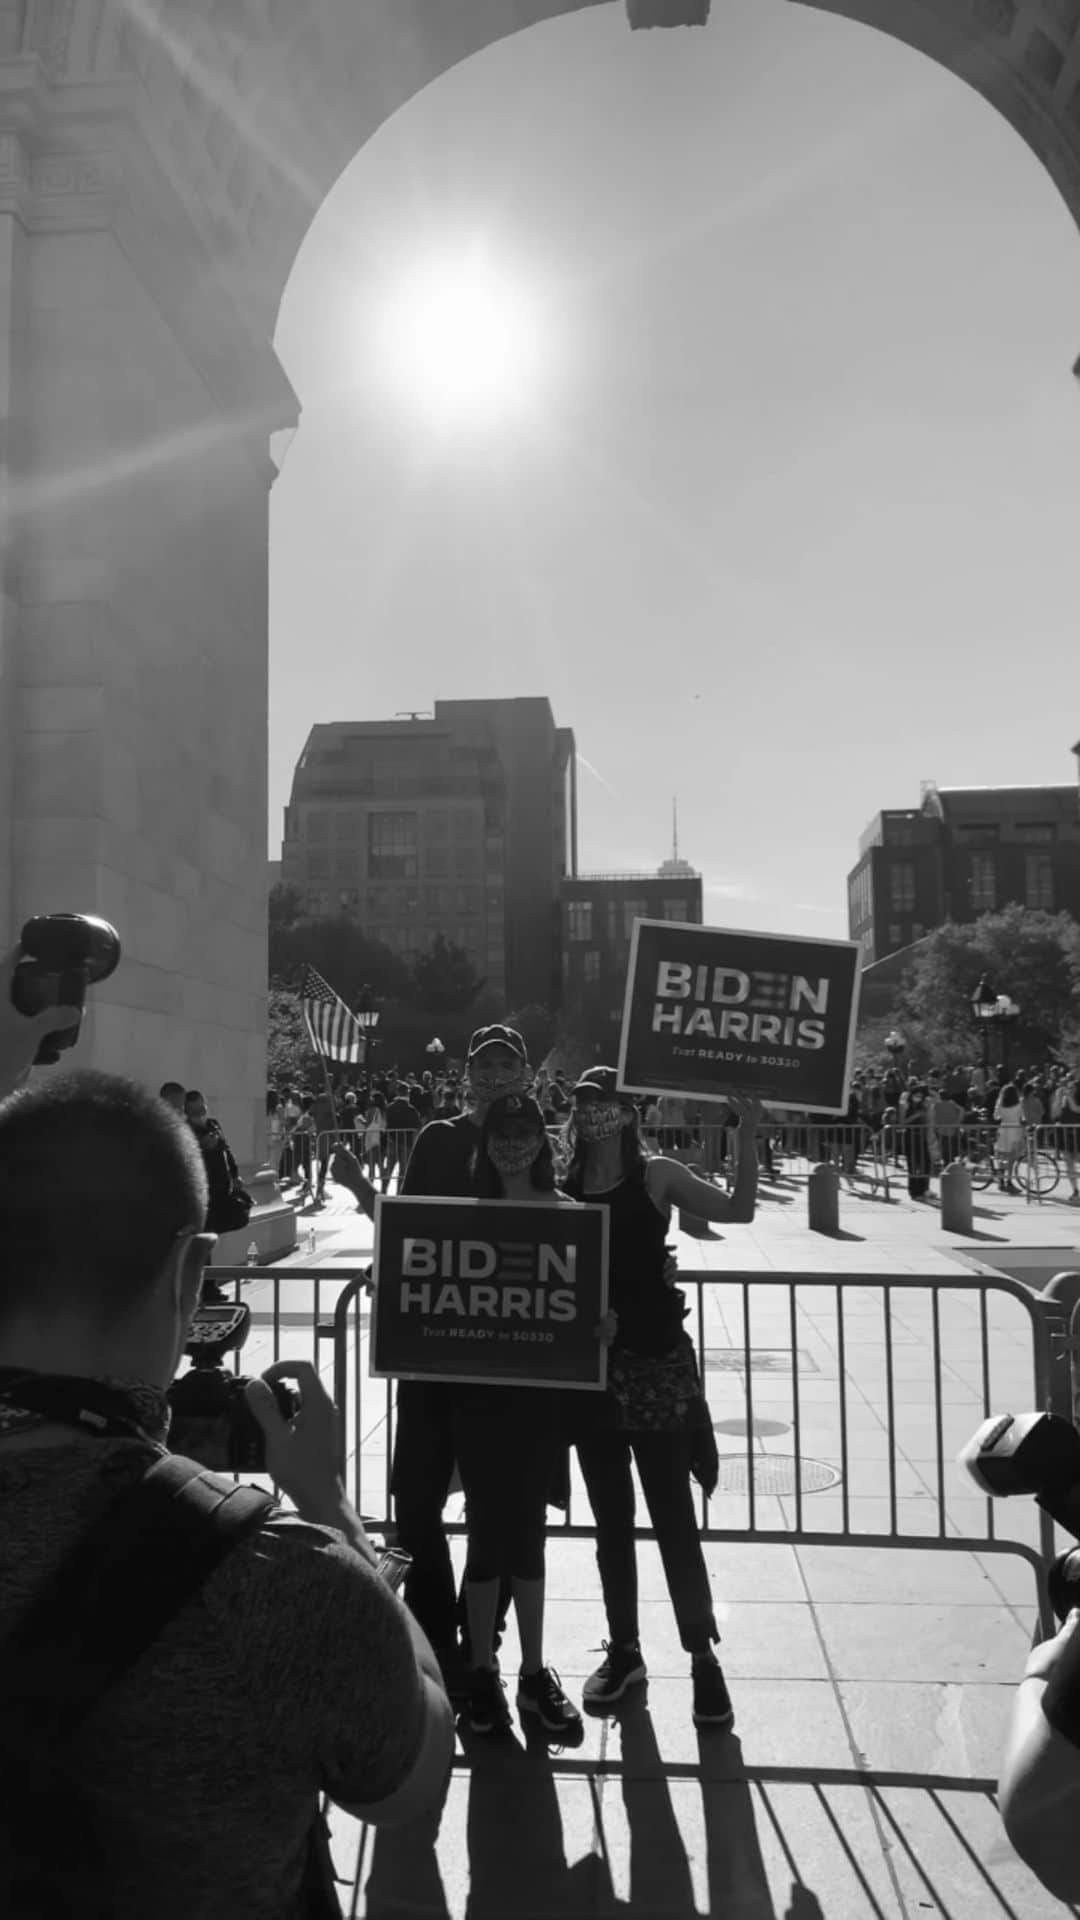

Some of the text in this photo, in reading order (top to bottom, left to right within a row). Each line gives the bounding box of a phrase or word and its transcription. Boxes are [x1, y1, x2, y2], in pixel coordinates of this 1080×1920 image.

[656, 961, 829, 1014] BIDEN
[652, 1002, 825, 1050] HARRIS
[698, 1049, 743, 1062] READY
[401, 1238, 577, 1283] BIDEN
[400, 1282, 577, 1321] HARRIS
[449, 1328, 495, 1339] READY
